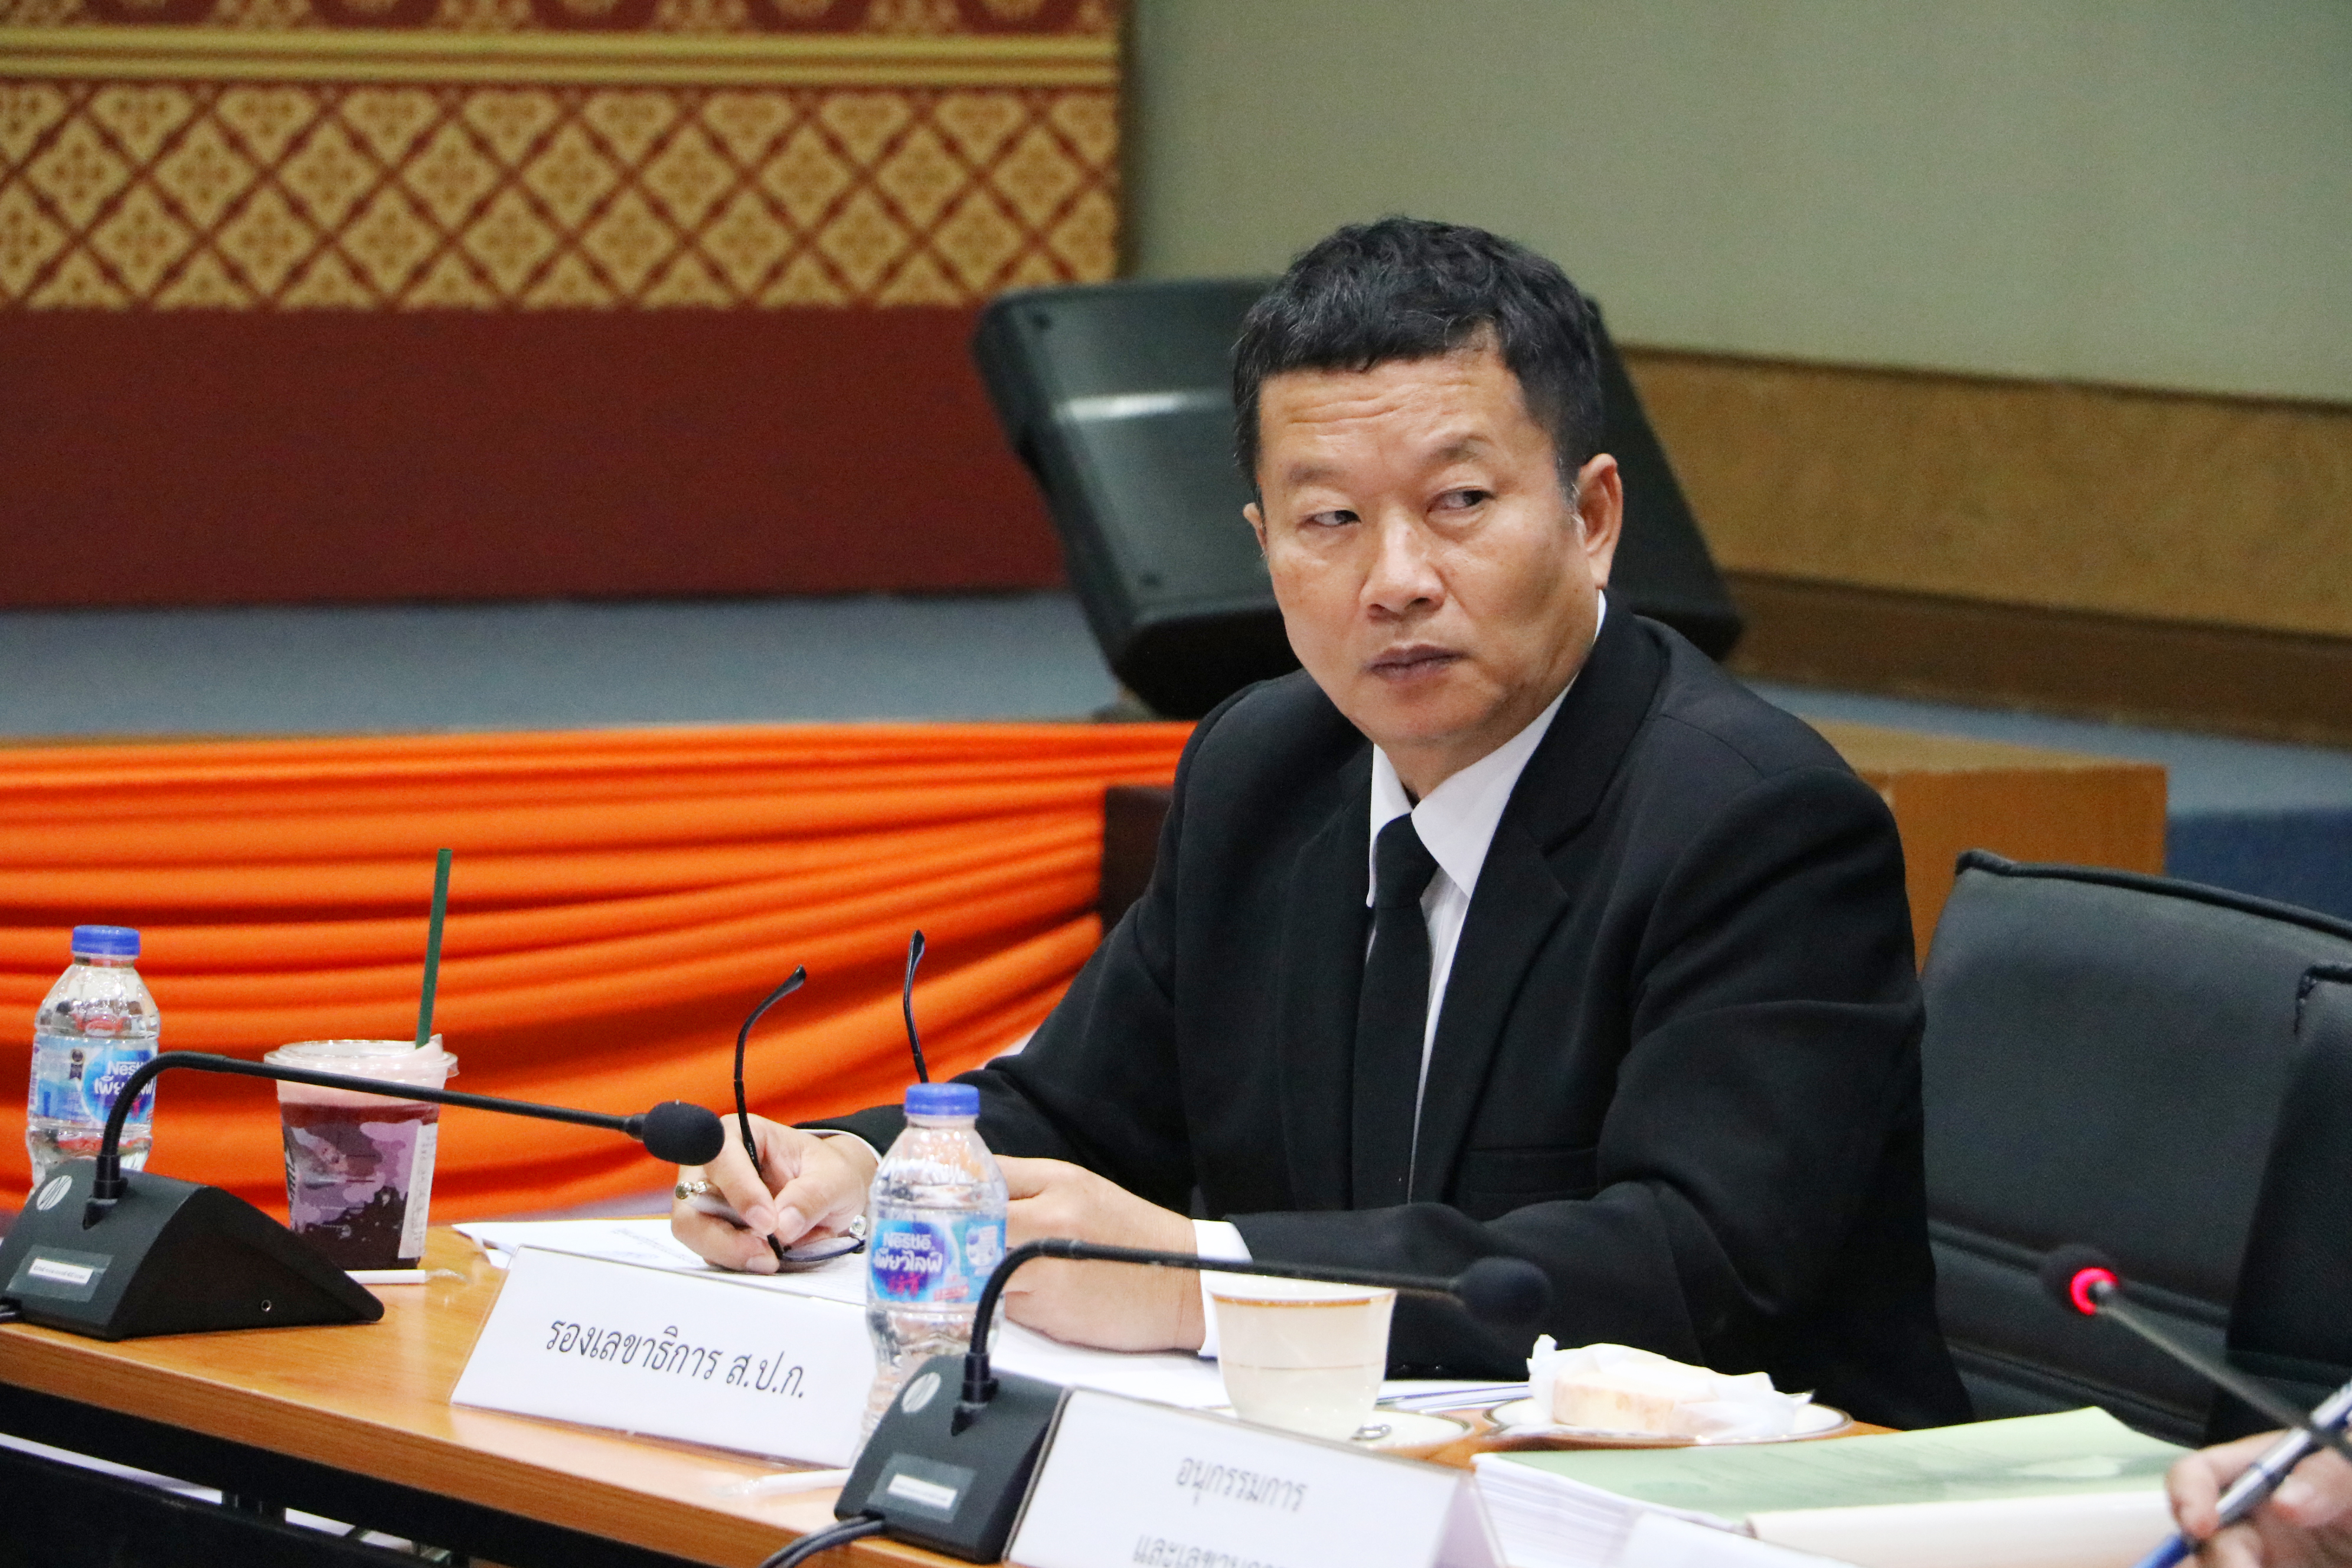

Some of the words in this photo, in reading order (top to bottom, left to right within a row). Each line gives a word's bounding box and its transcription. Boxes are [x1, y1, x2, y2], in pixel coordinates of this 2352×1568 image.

[883, 1231, 932, 1251] Nestlé
[546, 1319, 724, 1380] รองเลขาธิการ
[726, 1350, 804, 1399] ส.ป.ก.
[1176, 1456, 1308, 1512] อนุกรรมการ
